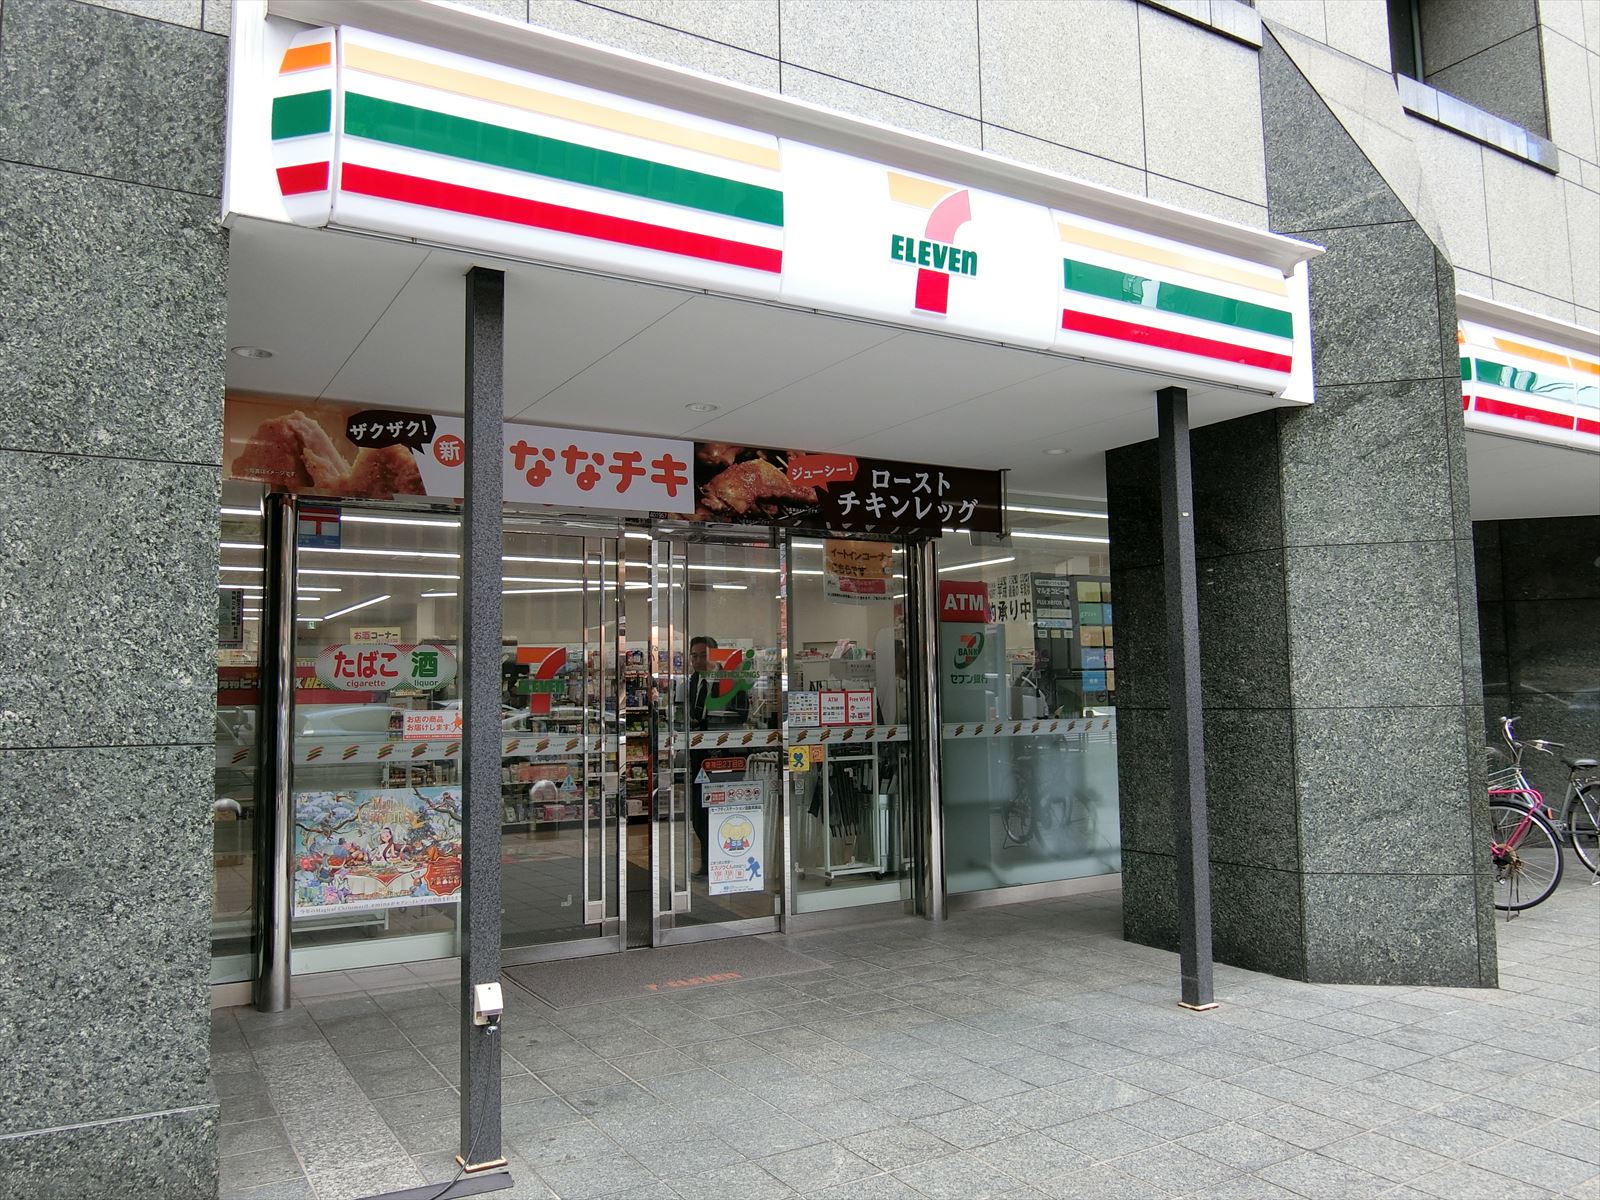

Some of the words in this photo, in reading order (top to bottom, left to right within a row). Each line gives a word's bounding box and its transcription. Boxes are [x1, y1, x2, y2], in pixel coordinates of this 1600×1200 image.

[439, 440, 461, 462] 新
[509, 440, 689, 498] ななチキ
[871, 469, 951, 497] ロースト
[837, 492, 979, 523] チキンレッグ
[944, 593, 984, 611] ATM
[353, 629, 399, 640] お酒コーナー
[333, 650, 399, 679] たばこ
[411, 651, 439, 678] 酒
[346, 679, 386, 689] cigarette
[414, 678, 439, 688] liquor
[950, 673, 988, 685] セブン銀行
[407, 715, 444, 723] お店の商品
